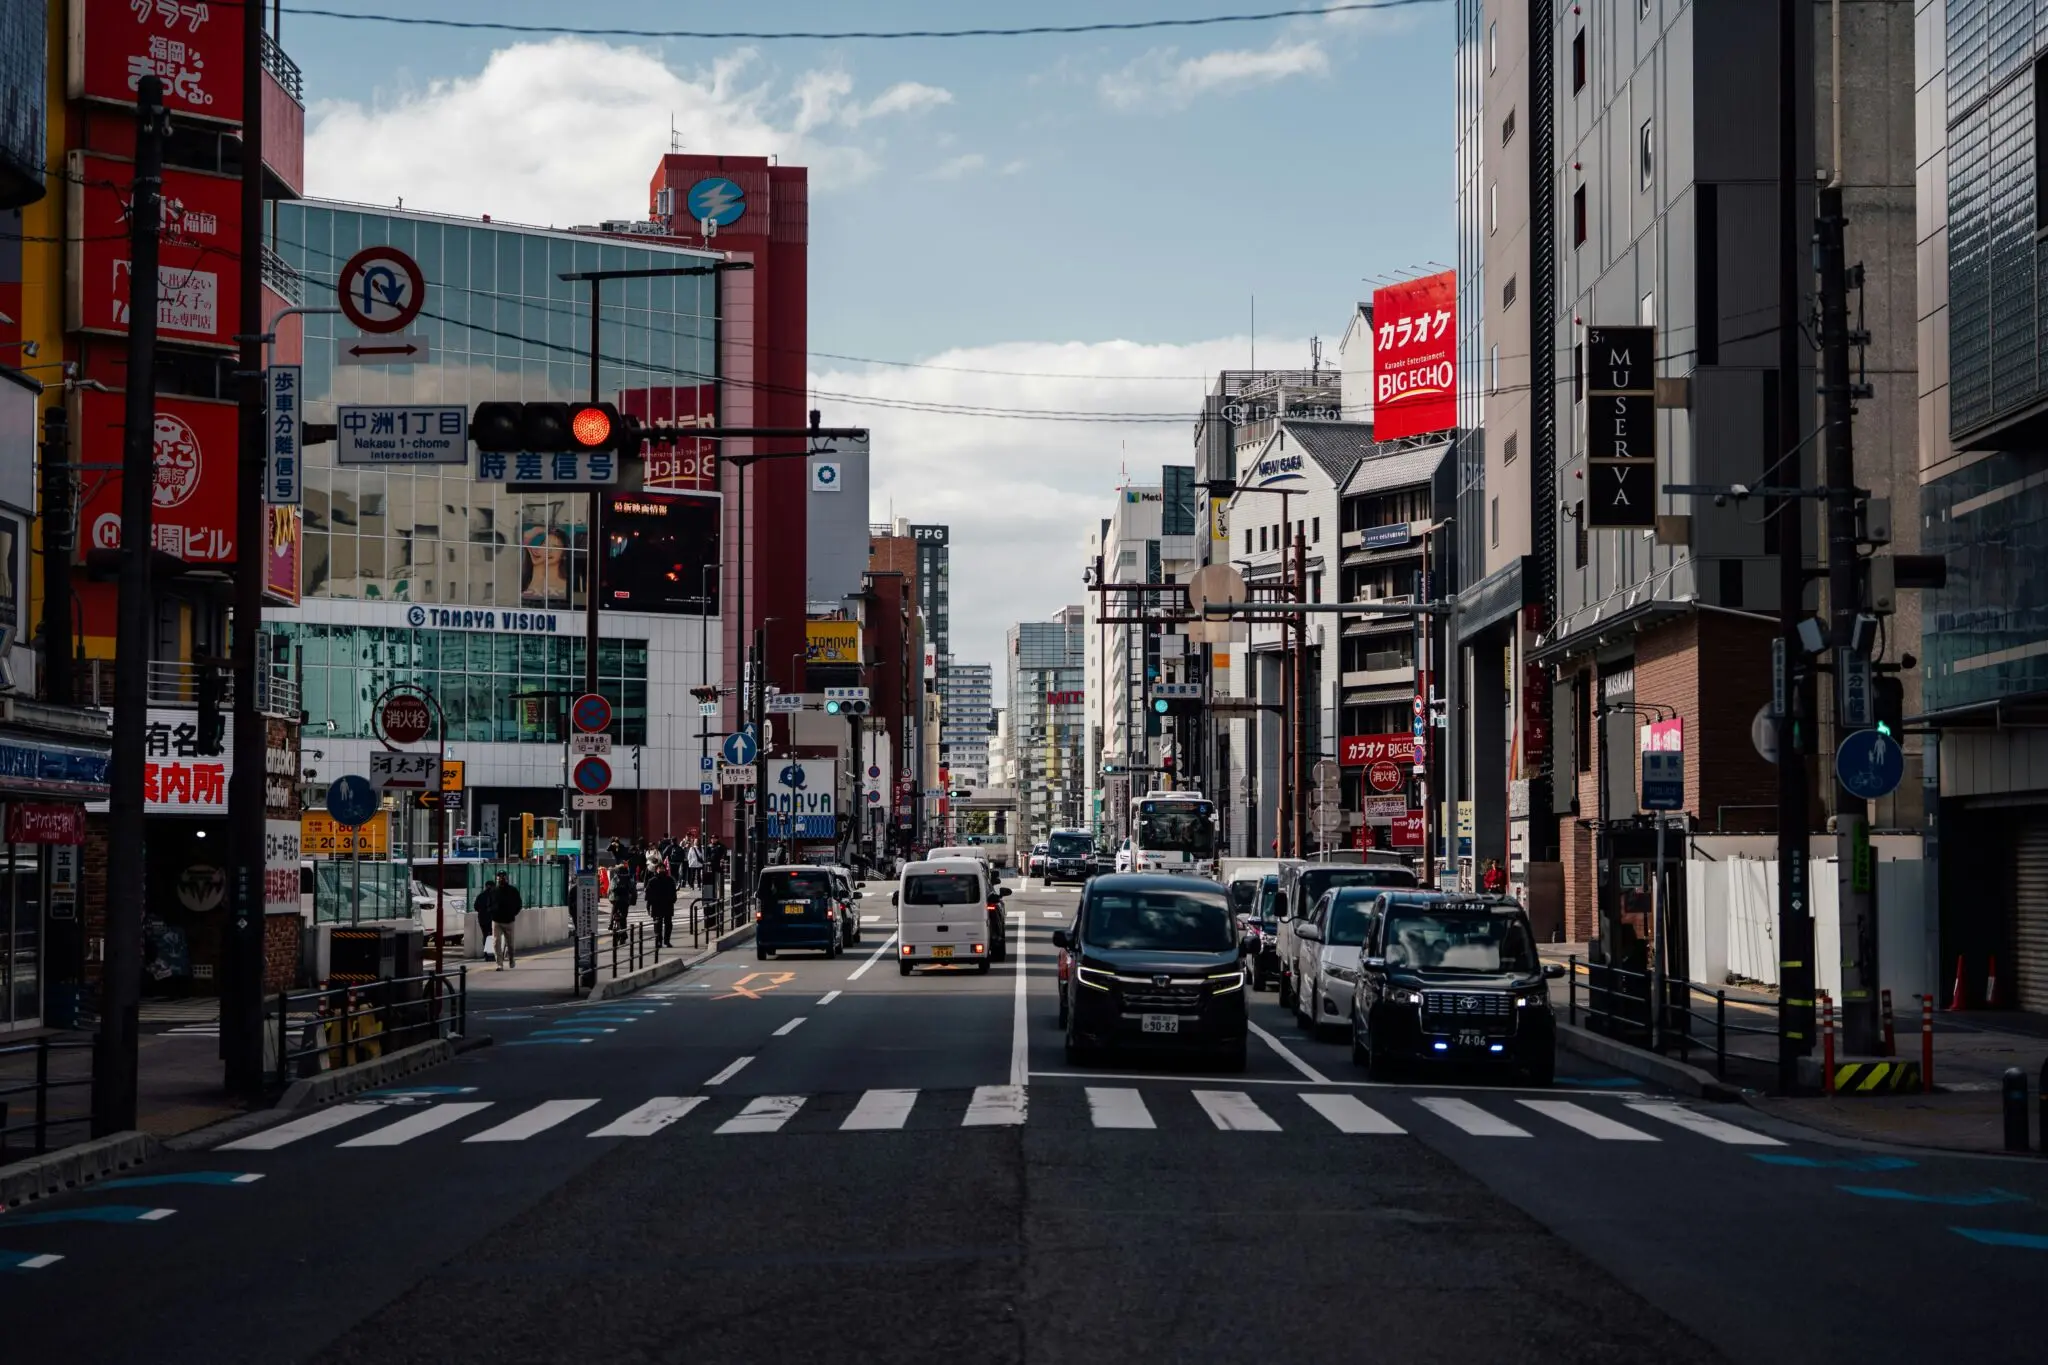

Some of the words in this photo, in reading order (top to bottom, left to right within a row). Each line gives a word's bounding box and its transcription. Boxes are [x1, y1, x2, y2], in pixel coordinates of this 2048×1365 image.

[149, 34, 185, 64] 福岡
[156, 61, 176, 77] DE
[1378, 309, 1451, 352] カラオケ
[1384, 358, 1405, 371] Karaoke
[1407, 350, 1446, 366] Entertainment
[1378, 369, 1408, 403] BIG
[1410, 360, 1454, 388] ECHO
[344, 411, 462, 436] 中洲1丁目
[1255, 405, 1309, 422] Dawa
[274, 371, 294, 498] 歩車分離信号
[354, 438, 397, 449] Nakasu
[399, 438, 451, 449] 1-chome
[154, 440, 194, 468] よこ
[370, 450, 435, 461] Intersection
[479, 452, 614, 481] 時差信号
[914, 529, 944, 540] FPG
[431, 608, 495, 630] TAMAYA
[502, 611, 557, 633] VISION
[385, 708, 428, 730] 消火栓
[1348, 741, 1386, 760] カラオケ
[1387, 743, 1402, 757] BIG
[372, 756, 438, 779] 河太郎
[1373, 769, 1398, 783] 消火栓
